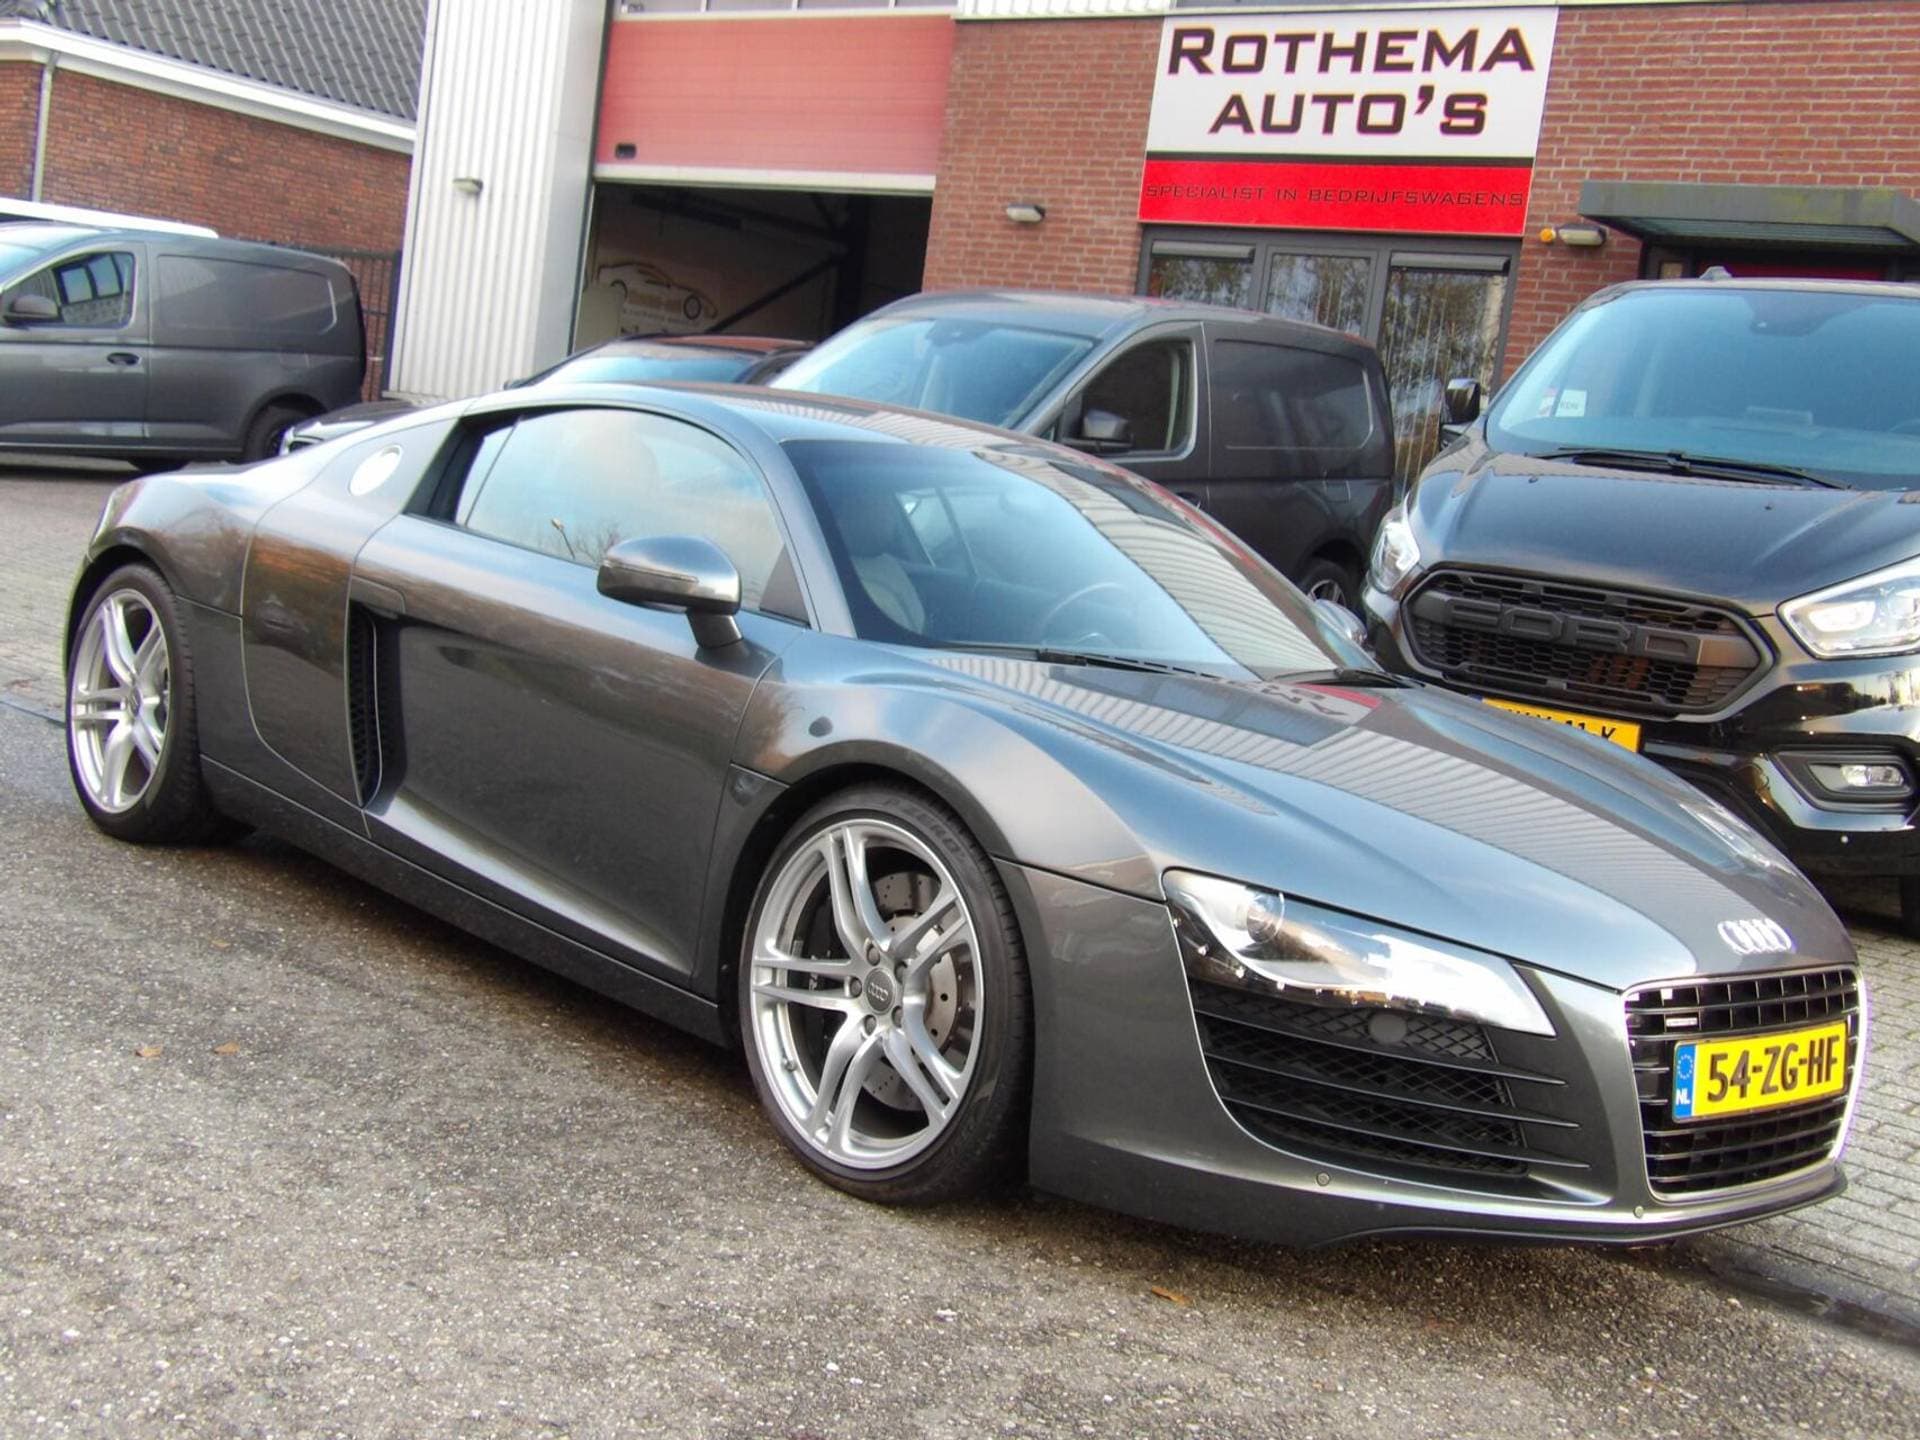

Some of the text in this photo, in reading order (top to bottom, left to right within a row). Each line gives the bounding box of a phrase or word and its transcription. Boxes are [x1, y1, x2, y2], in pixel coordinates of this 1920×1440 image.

[1168, 27, 1535, 74] ROTHEMA
[1208, 85, 1488, 136] AUTO'S
[1146, 184, 1524, 208] SPECIALIST IN BEDRIJFSWAGENS
[1446, 598, 1698, 664] FORD
[1675, 1034, 1840, 1105] NL 54-ZG-HF
